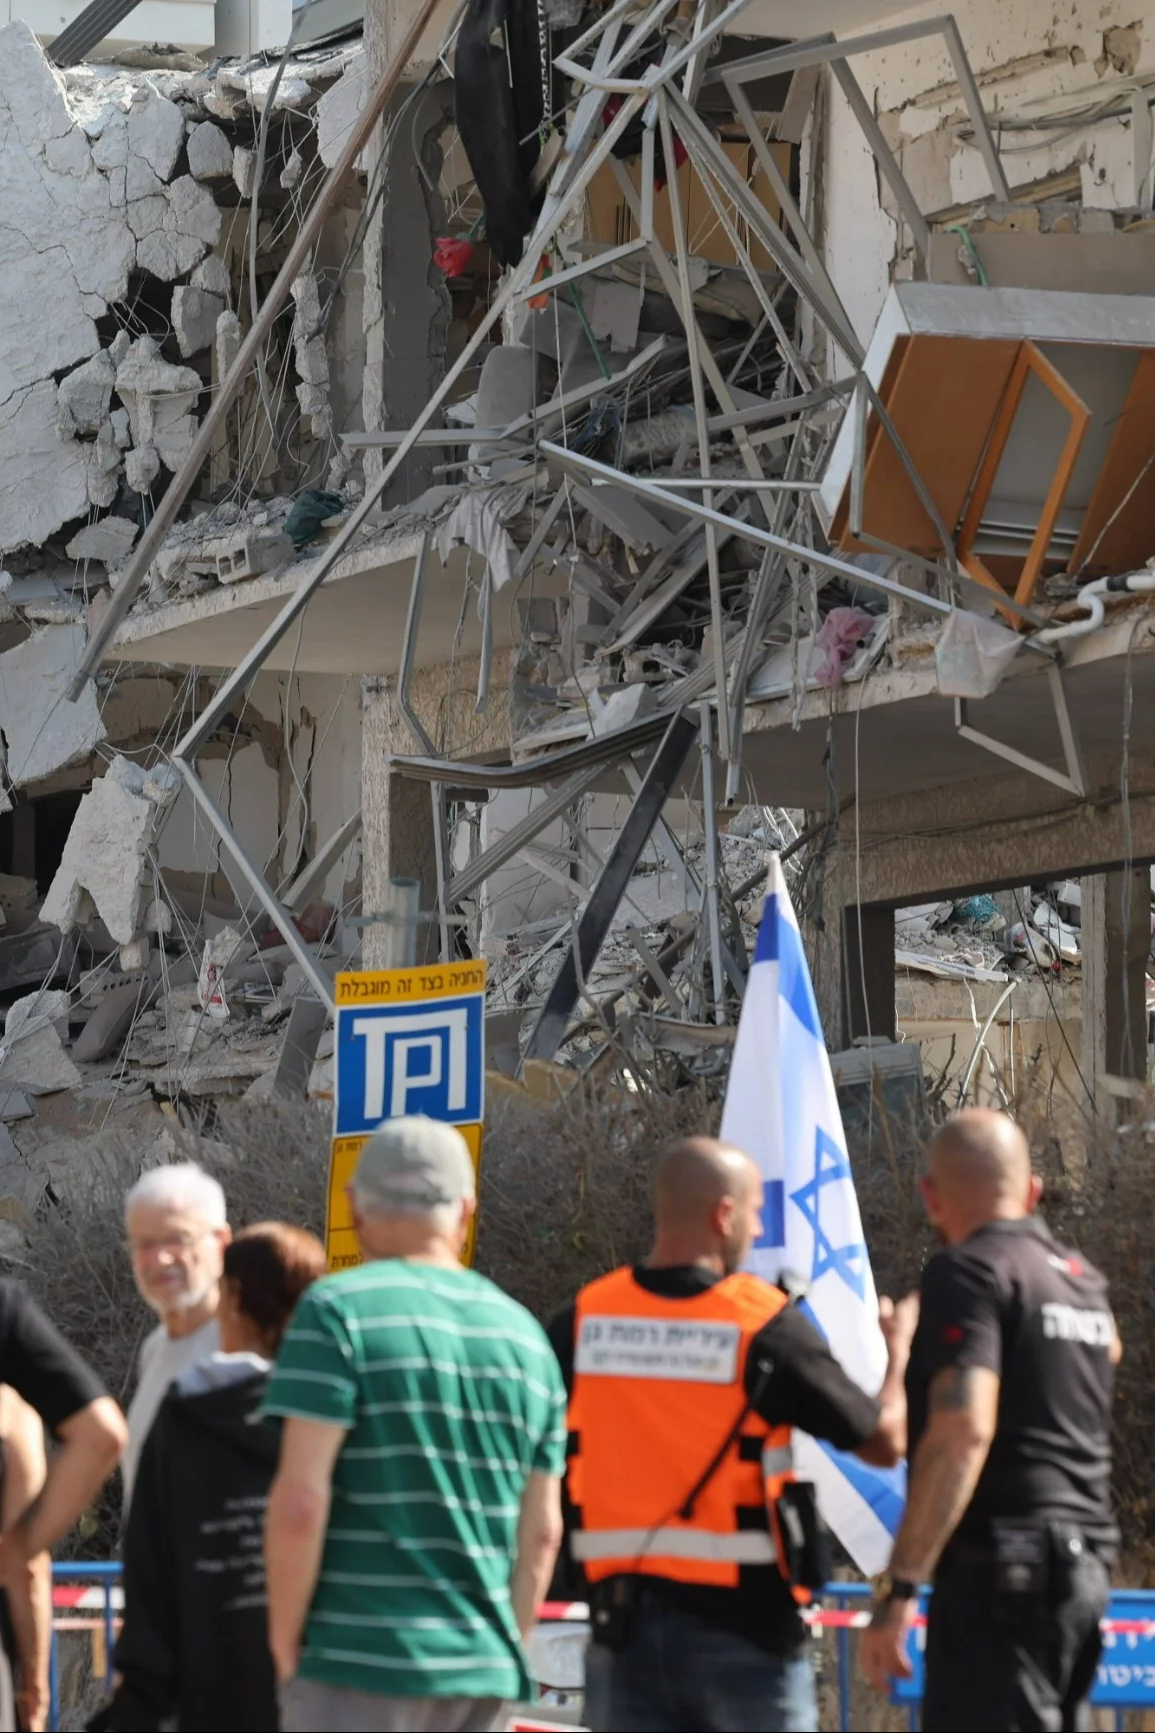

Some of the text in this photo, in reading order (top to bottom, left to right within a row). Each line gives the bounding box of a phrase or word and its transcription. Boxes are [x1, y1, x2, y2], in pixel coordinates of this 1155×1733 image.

[340, 969, 483, 998] החניה בצד זה מוגבלת
